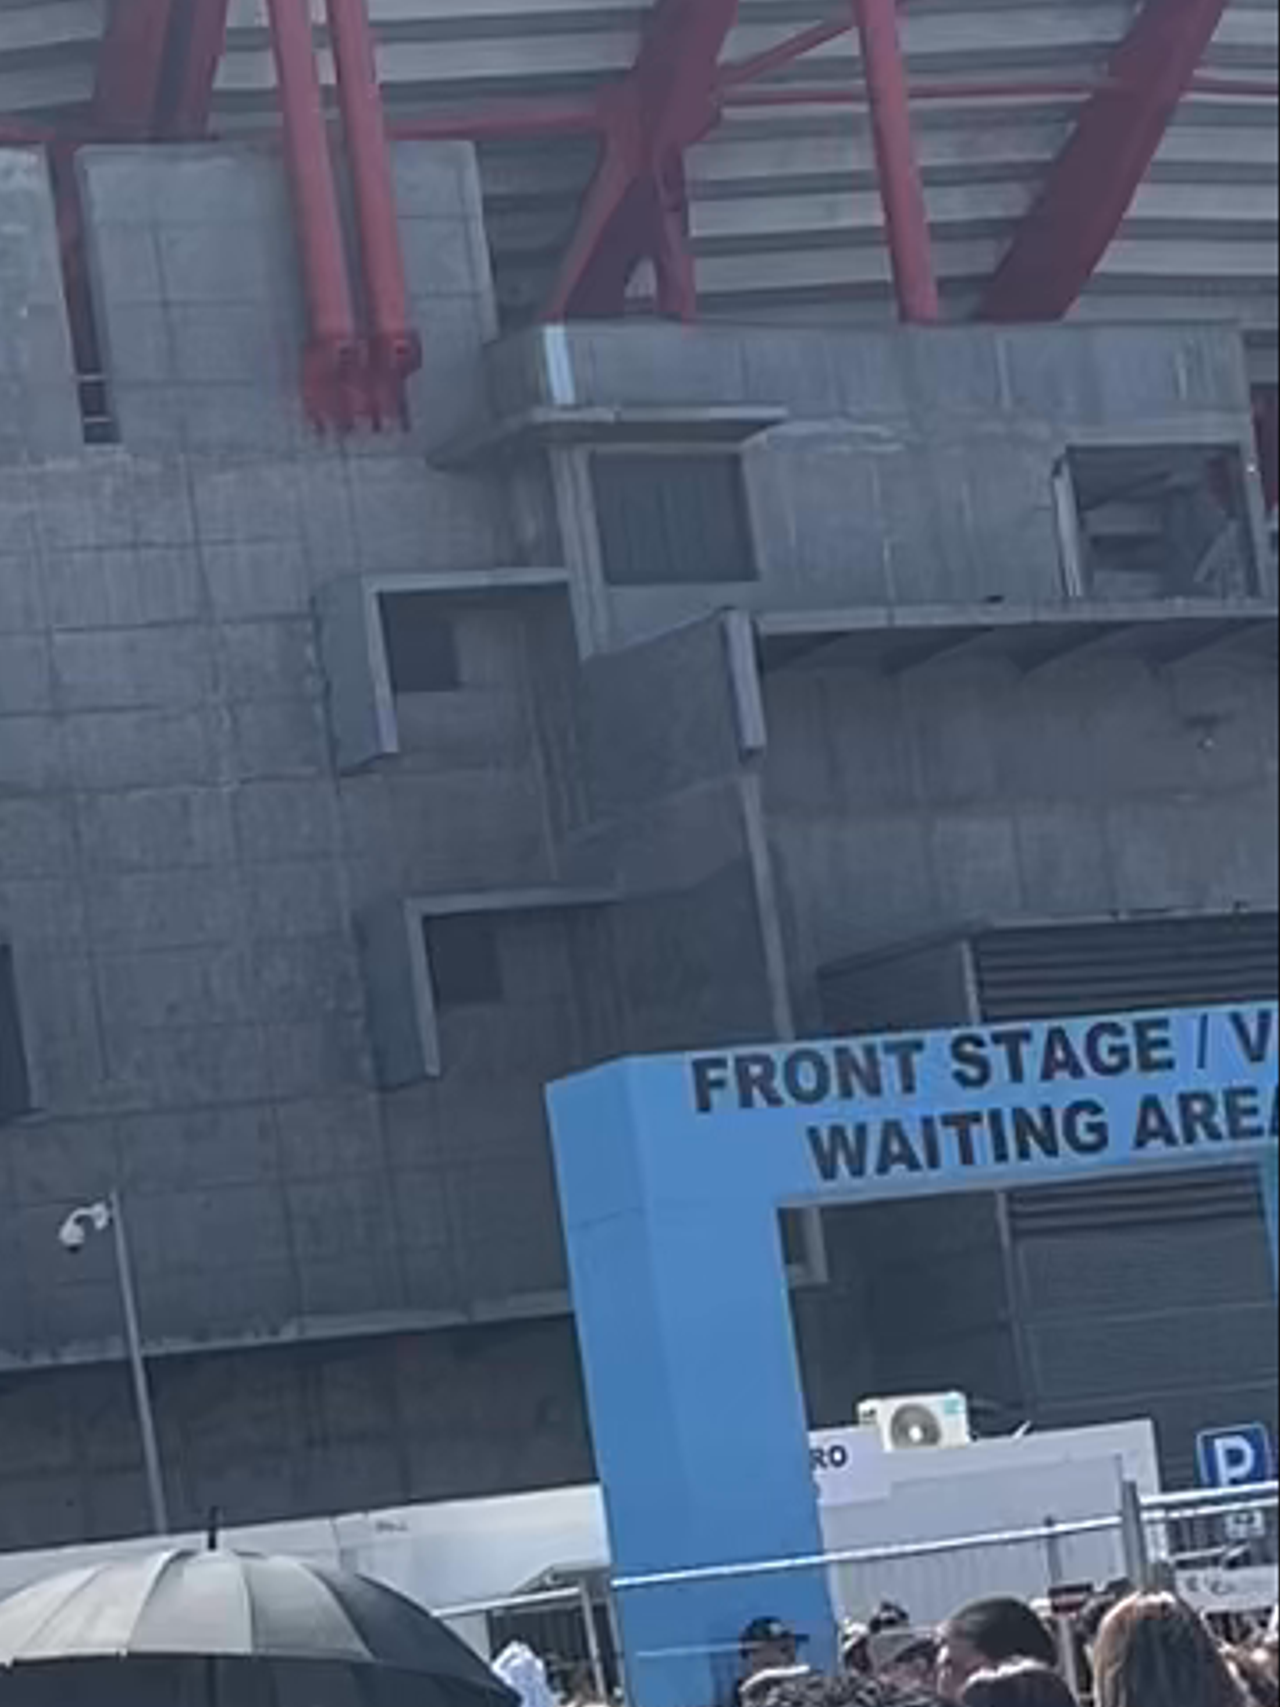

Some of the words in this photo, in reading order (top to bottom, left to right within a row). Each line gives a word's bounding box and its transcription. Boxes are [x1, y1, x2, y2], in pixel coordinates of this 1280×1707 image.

[690, 1039, 926, 1114] FRONT
[948, 1016, 1176, 1089] STAGE
[805, 1097, 1110, 1182] WAITING
[1214, 1434, 1256, 1487] P
